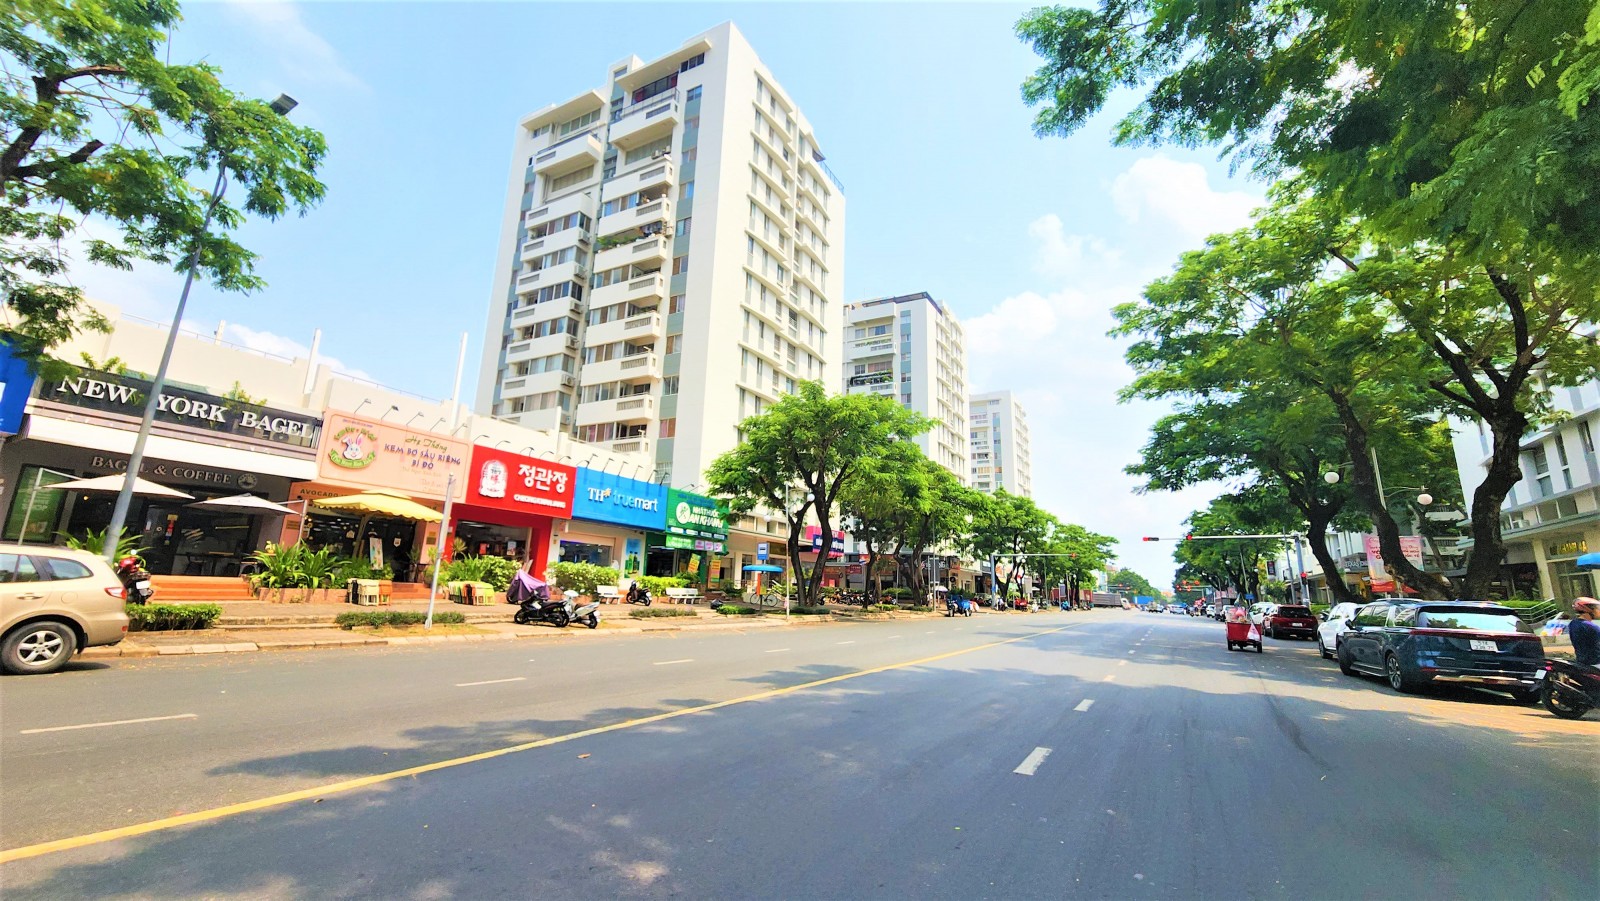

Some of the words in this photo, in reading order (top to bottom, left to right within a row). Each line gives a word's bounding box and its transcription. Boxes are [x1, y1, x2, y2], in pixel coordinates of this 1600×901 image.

[57, 376, 137, 404] NEW
[156, 394, 228, 423] YORK
[239, 410, 313, 439] BAGEL
[384, 443, 404, 454] KEM
[91, 456, 149, 475] BAGL
[153, 465, 167, 475] &
[172, 467, 232, 485] COFFEE
[518, 464, 568, 493] 정관장
[300, 488, 338, 498] AVOCADO
[588, 487, 604, 502] TH
